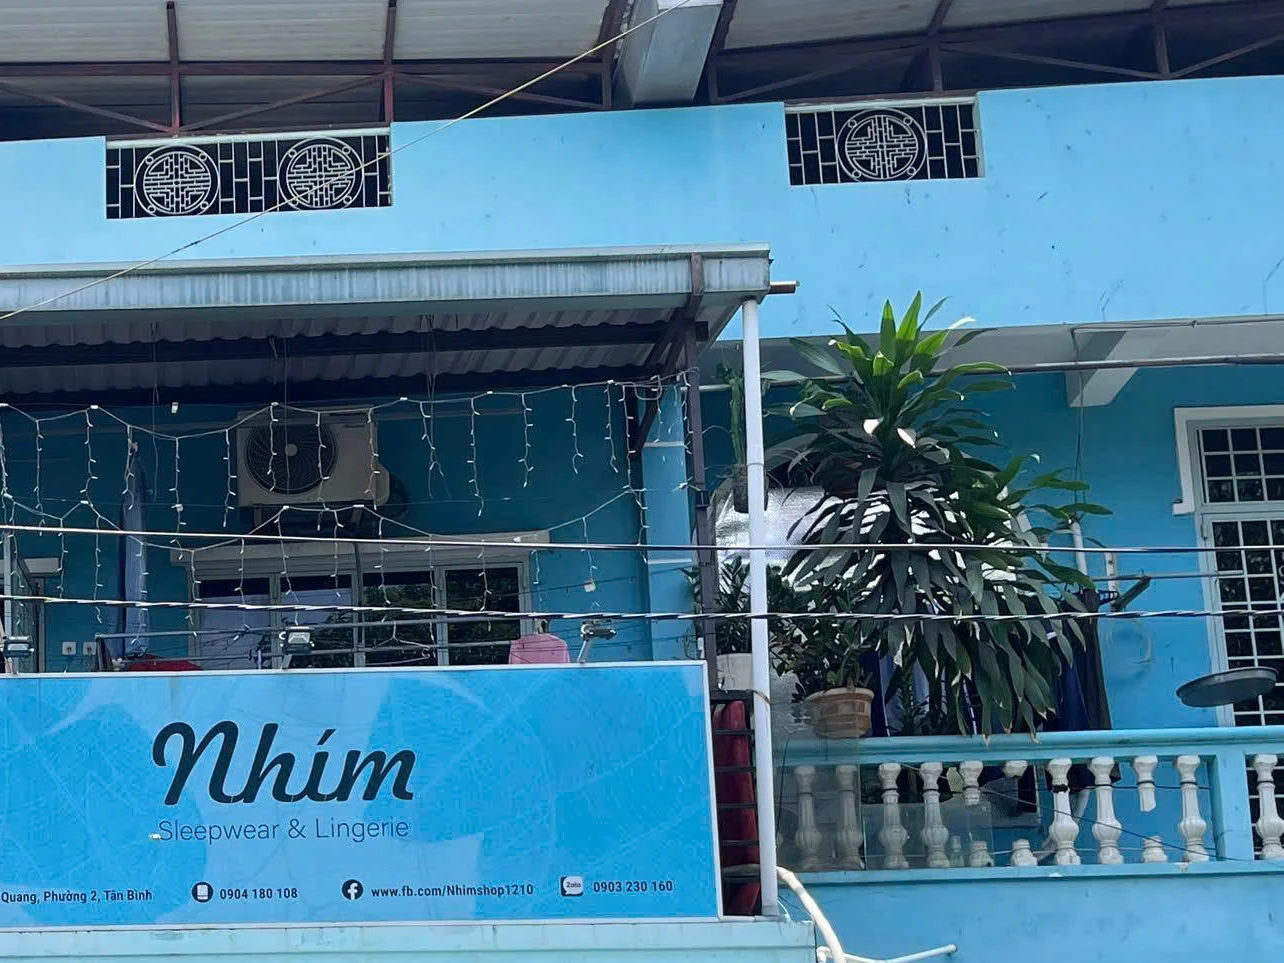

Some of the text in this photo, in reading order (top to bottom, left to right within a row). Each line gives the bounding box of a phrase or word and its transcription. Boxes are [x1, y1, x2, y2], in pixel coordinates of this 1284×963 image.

[152, 720, 416, 806] Nhím
[158, 816, 409, 845] Sleepwear & Lingerie
[219, 887, 298, 900] 0904 180 108
[371, 884, 534, 898] www.fb.com/Nhimshop1210
[593, 880, 673, 893] 0903 230 160
[1, 891, 40, 905] Quang,
[43, 889, 87, 904] Phường
[90, 890, 101, 903] 2,
[104, 889, 123, 901] Tân
[126, 888, 152, 901] Bình
